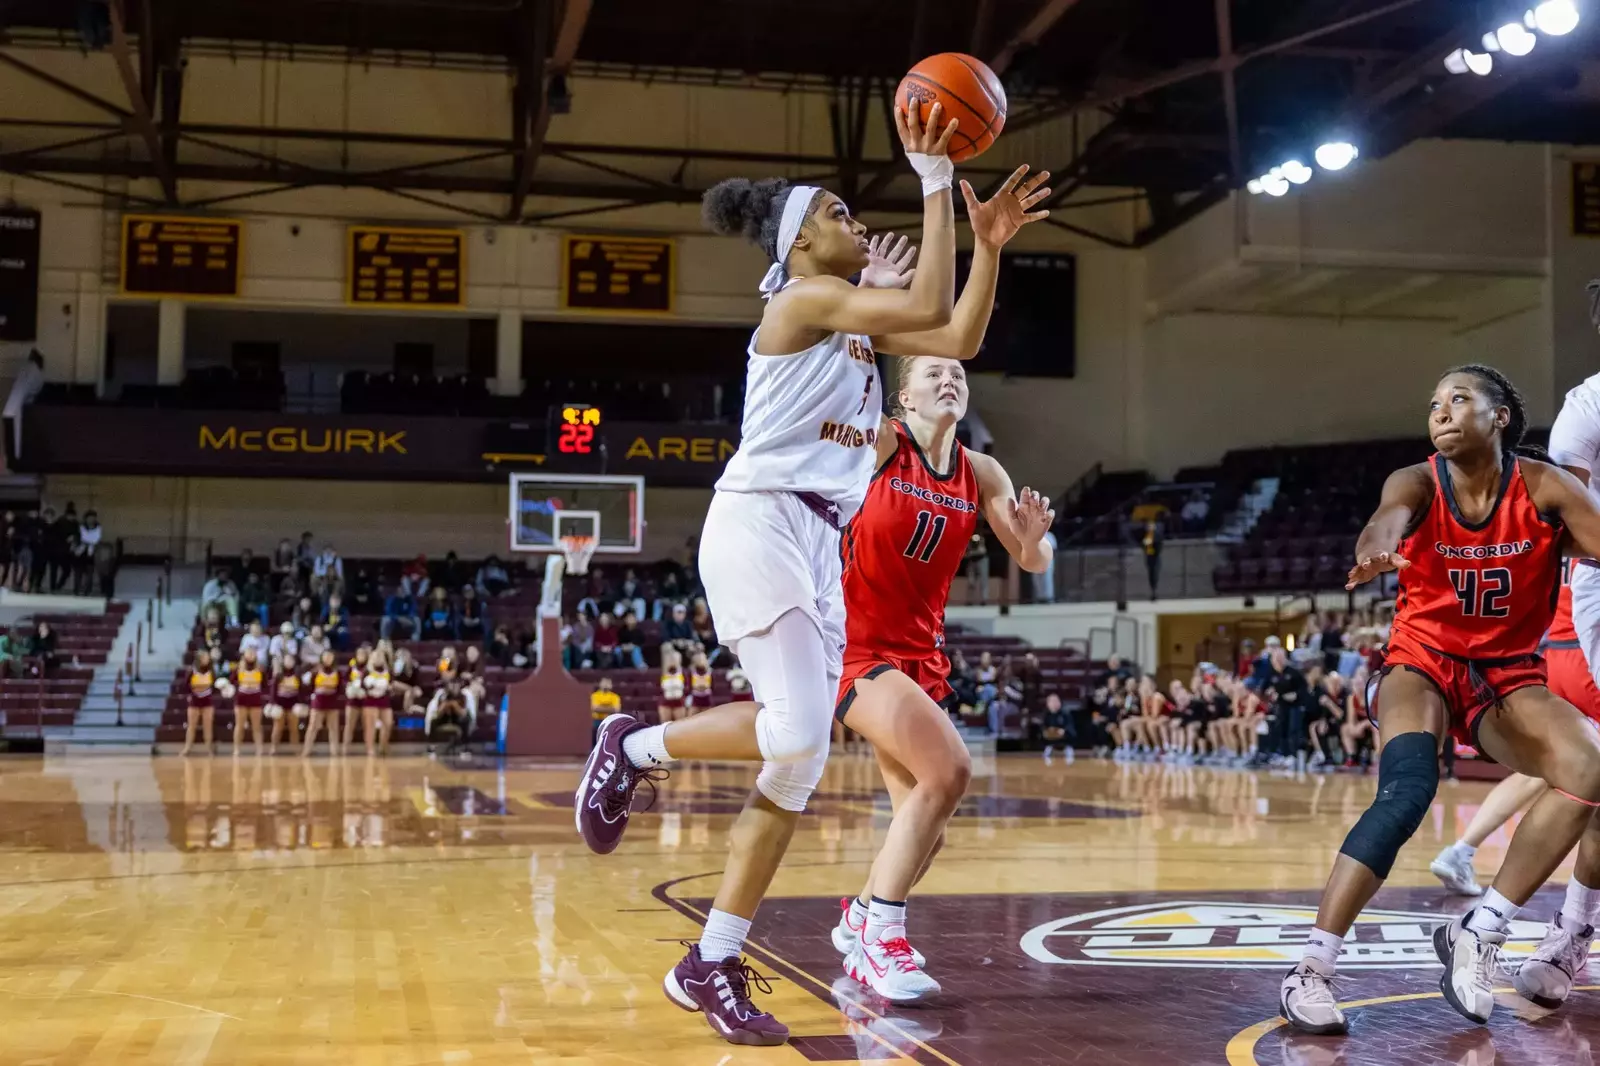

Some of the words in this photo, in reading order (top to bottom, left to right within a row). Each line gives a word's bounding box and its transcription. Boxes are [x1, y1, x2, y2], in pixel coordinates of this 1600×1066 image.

[199, 425, 408, 454] McGUIRK
[624, 437, 739, 462] AREN
[559, 423, 593, 453] 22
[890, 477, 976, 513] CONCORDIA
[903, 510, 947, 563] 11
[1449, 568, 1513, 618] 42
